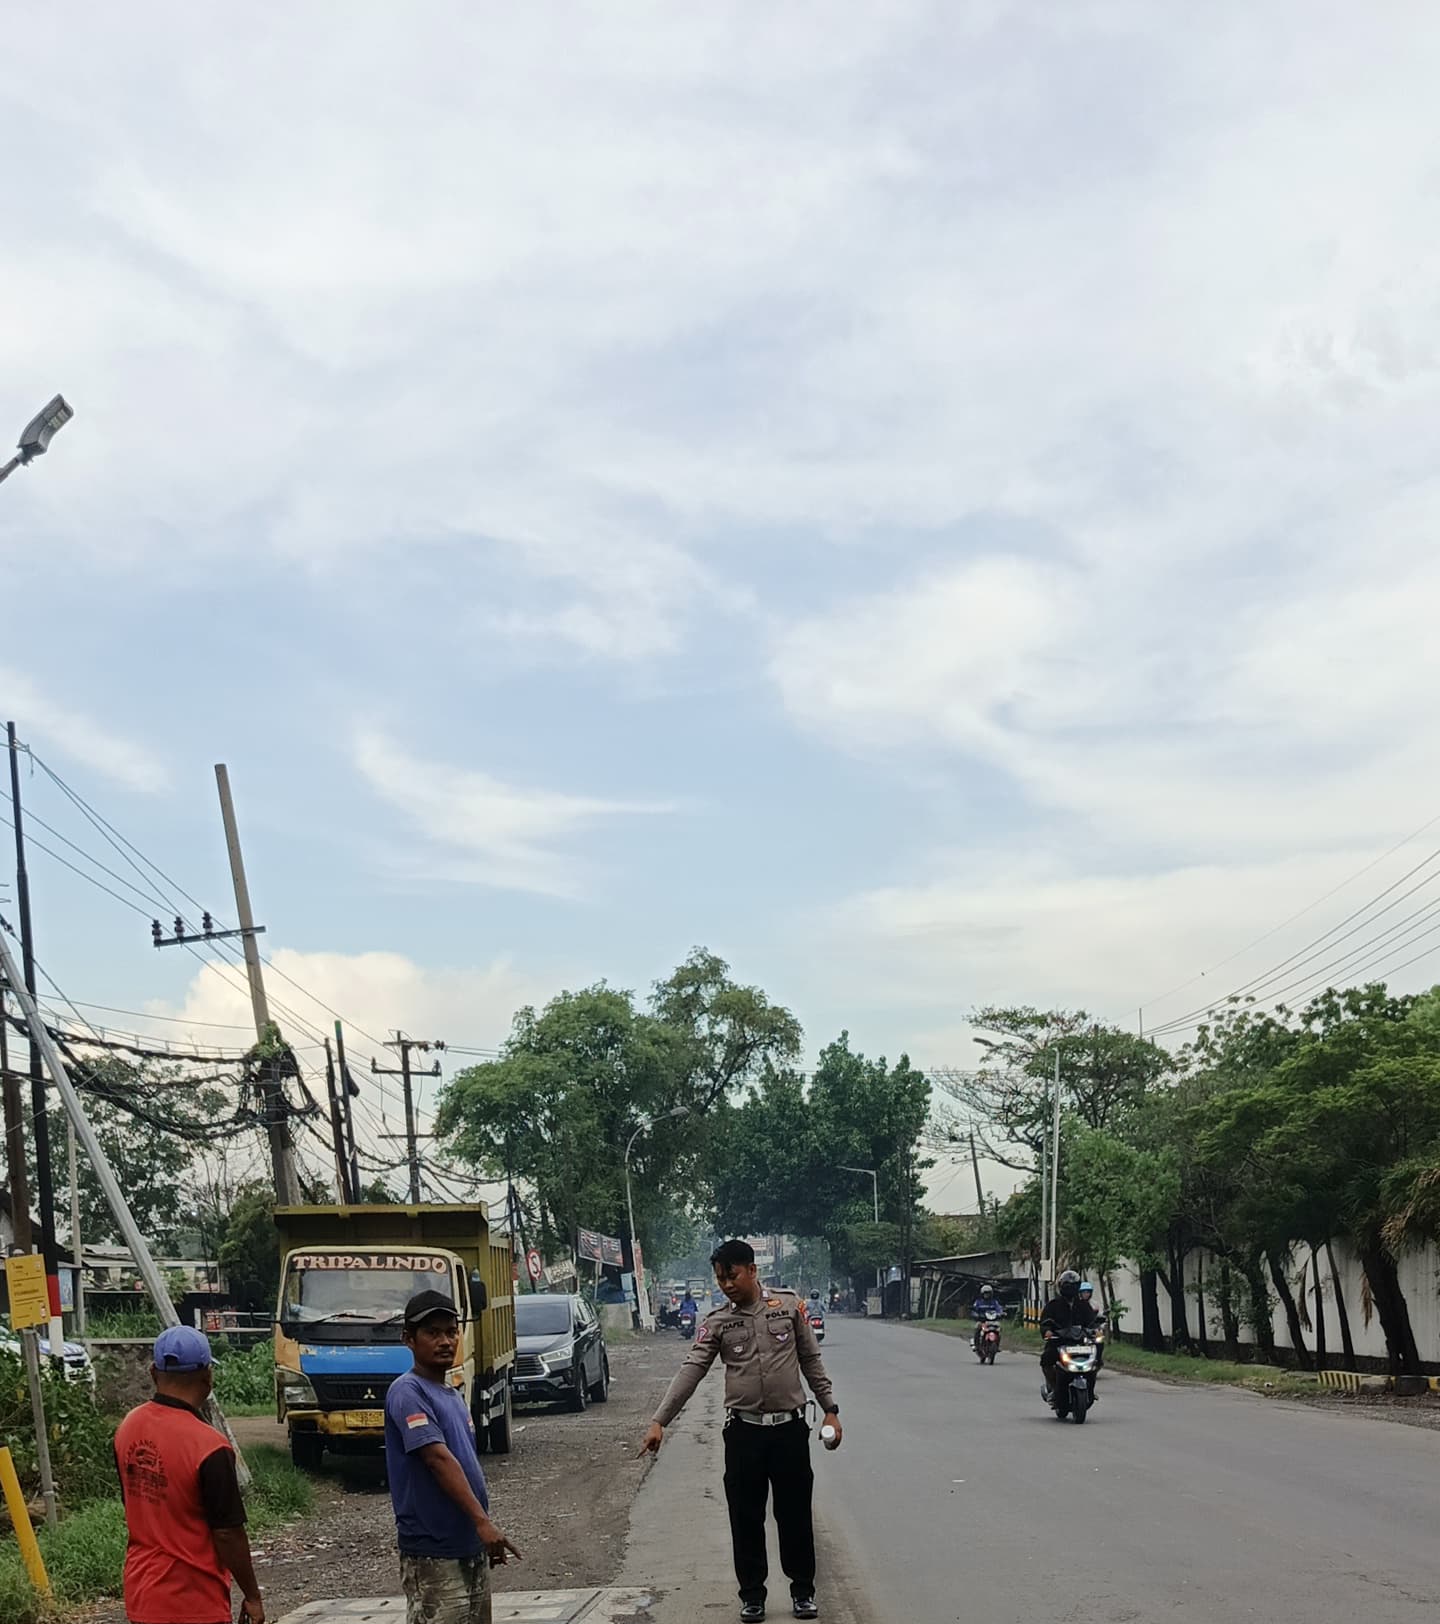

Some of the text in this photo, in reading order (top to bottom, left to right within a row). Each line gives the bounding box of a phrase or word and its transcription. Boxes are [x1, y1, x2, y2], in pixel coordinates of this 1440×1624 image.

[292, 1255, 447, 1273] TRIPALINDO
[765, 1311, 789, 1320] POLRI
[722, 1320, 746, 1331] HAFIZ
